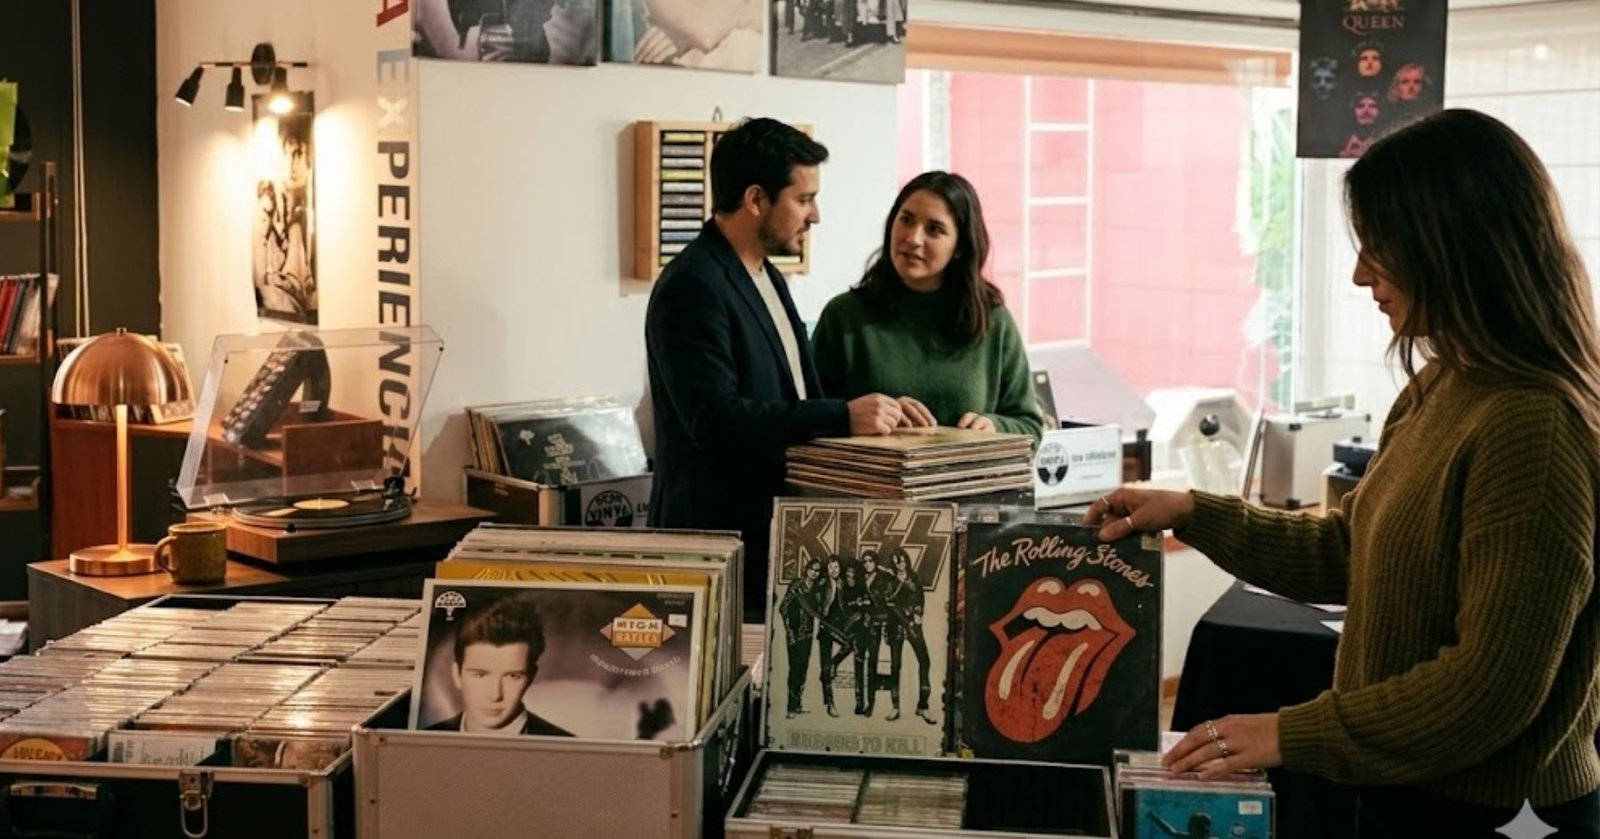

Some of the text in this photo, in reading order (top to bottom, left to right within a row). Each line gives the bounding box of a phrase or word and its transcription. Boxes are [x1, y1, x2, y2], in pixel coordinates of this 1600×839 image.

[1342, 14, 1405, 36] QUEEN
[778, 505, 951, 592] KISS
[973, 535, 1154, 588] The Rolling Stones
